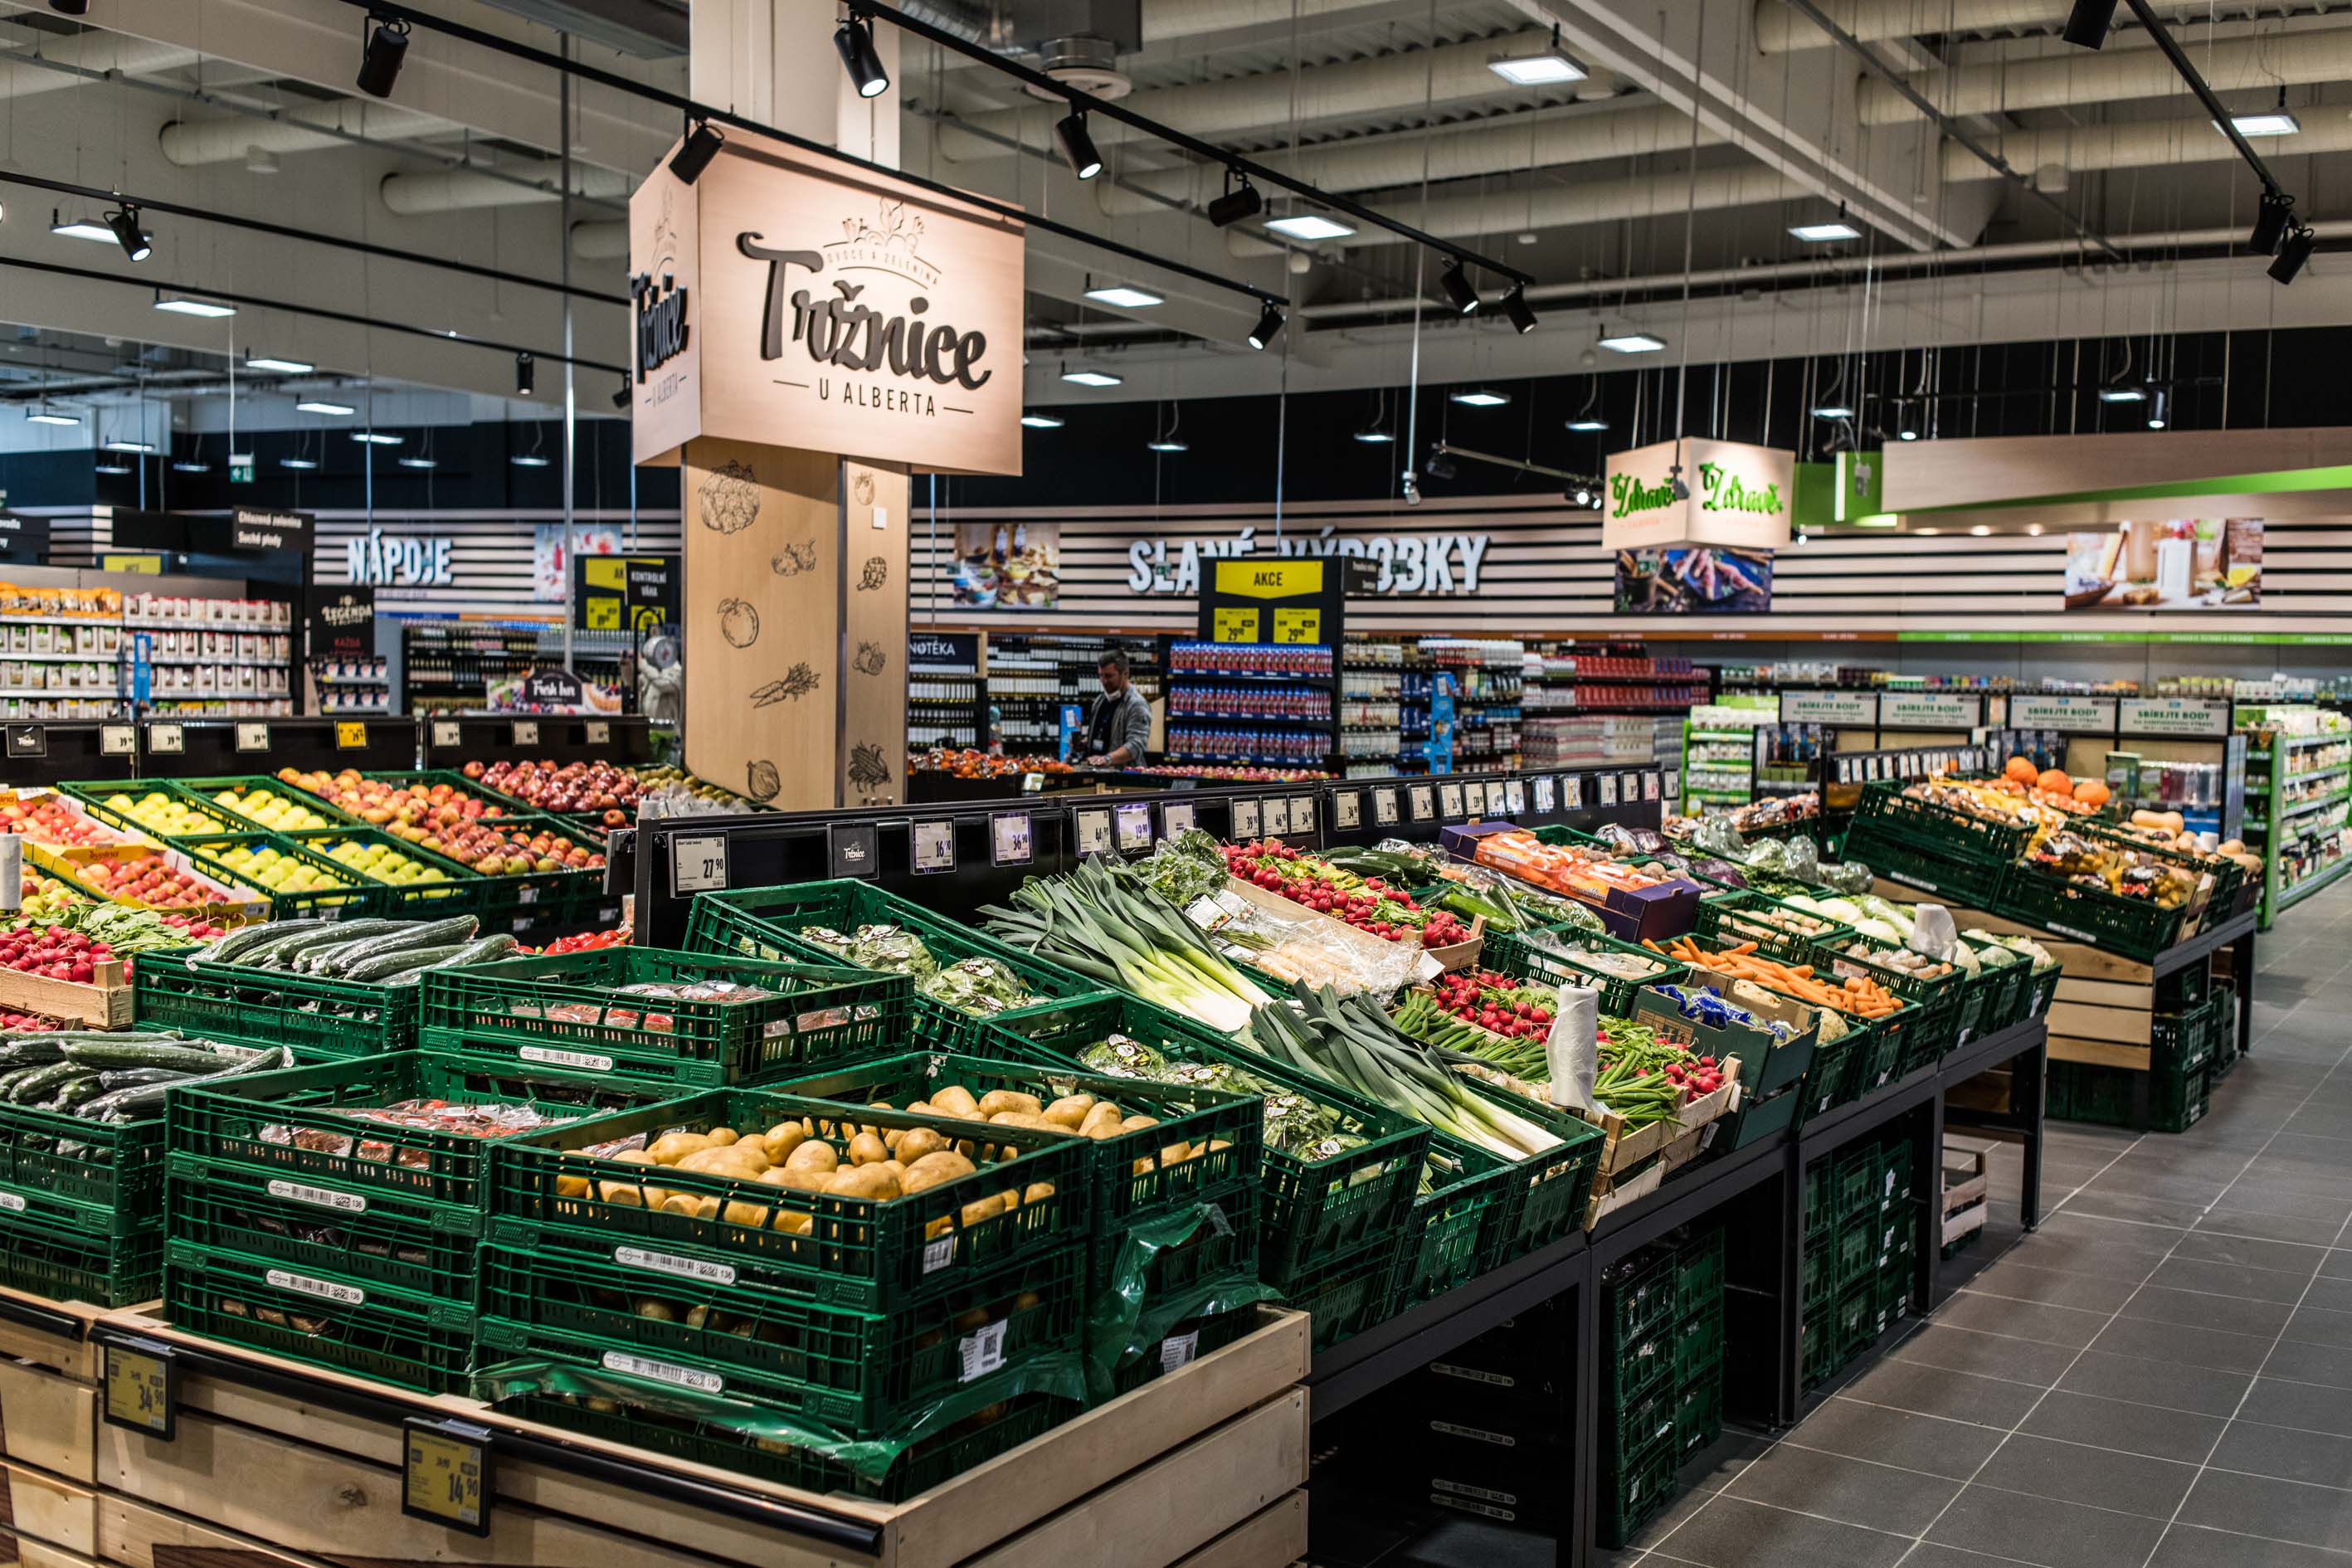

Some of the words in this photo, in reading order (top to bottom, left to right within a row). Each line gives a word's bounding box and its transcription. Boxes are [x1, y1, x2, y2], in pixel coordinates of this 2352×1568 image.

[736, 231, 991, 390] Tržnice
[819, 377, 830, 401] U
[843, 381, 936, 416] ALBERTA
[346, 527, 453, 586] NÁPOJE
[1254, 572, 1283, 587] AKCE
[935, 840, 944, 859] 16
[1012, 835, 1022, 851] 36
[703, 859, 714, 879] 27
[715, 858, 724, 870] 90
[600, 1059, 611, 1068] 136
[352, 1199, 363, 1209] 136
[720, 1269, 733, 1281] 136
[349, 1290, 360, 1302] 136
[707, 1378, 719, 1388] 136
[138, 1383, 153, 1413] 34
[154, 1388, 164, 1406] 90
[448, 1473, 464, 1505] 14
[466, 1477, 480, 1497] 90
